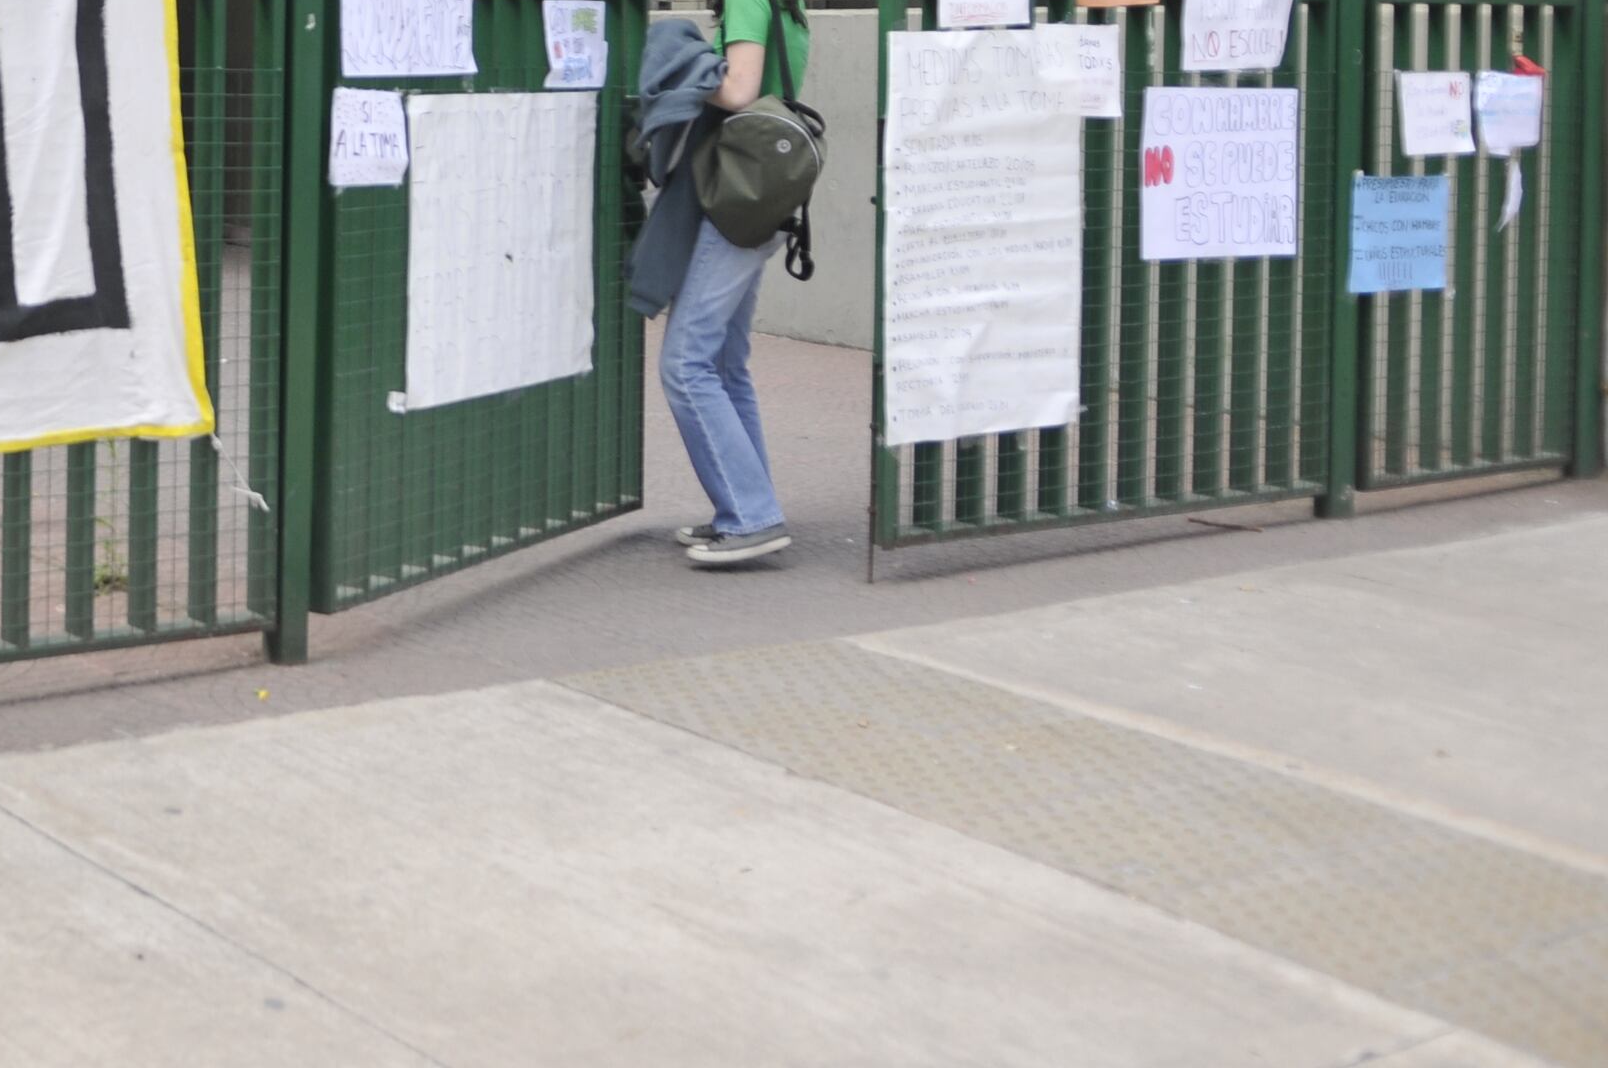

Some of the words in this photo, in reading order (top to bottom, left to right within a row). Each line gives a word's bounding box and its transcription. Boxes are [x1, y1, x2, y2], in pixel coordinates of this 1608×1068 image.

[906, 45, 983, 87] MEDIDAS
[992, 40, 1065, 79] TOMADAS
[900, 96, 973, 130] PREVIAS
[981, 94, 991, 113] A
[994, 92, 1010, 112] LA
[1016, 90, 1065, 114] TOMA
[1152, 94, 1213, 136] CON
[1215, 93, 1296, 133] HAMBRE
[335, 130, 348, 159] A
[353, 132, 368, 157] LA
[1144, 145, 1175, 188] NO
[1184, 140, 1217, 188] SE
[1221, 140, 1295, 186] PUEDE
[1175, 191, 1294, 246] ESTUDIAR
